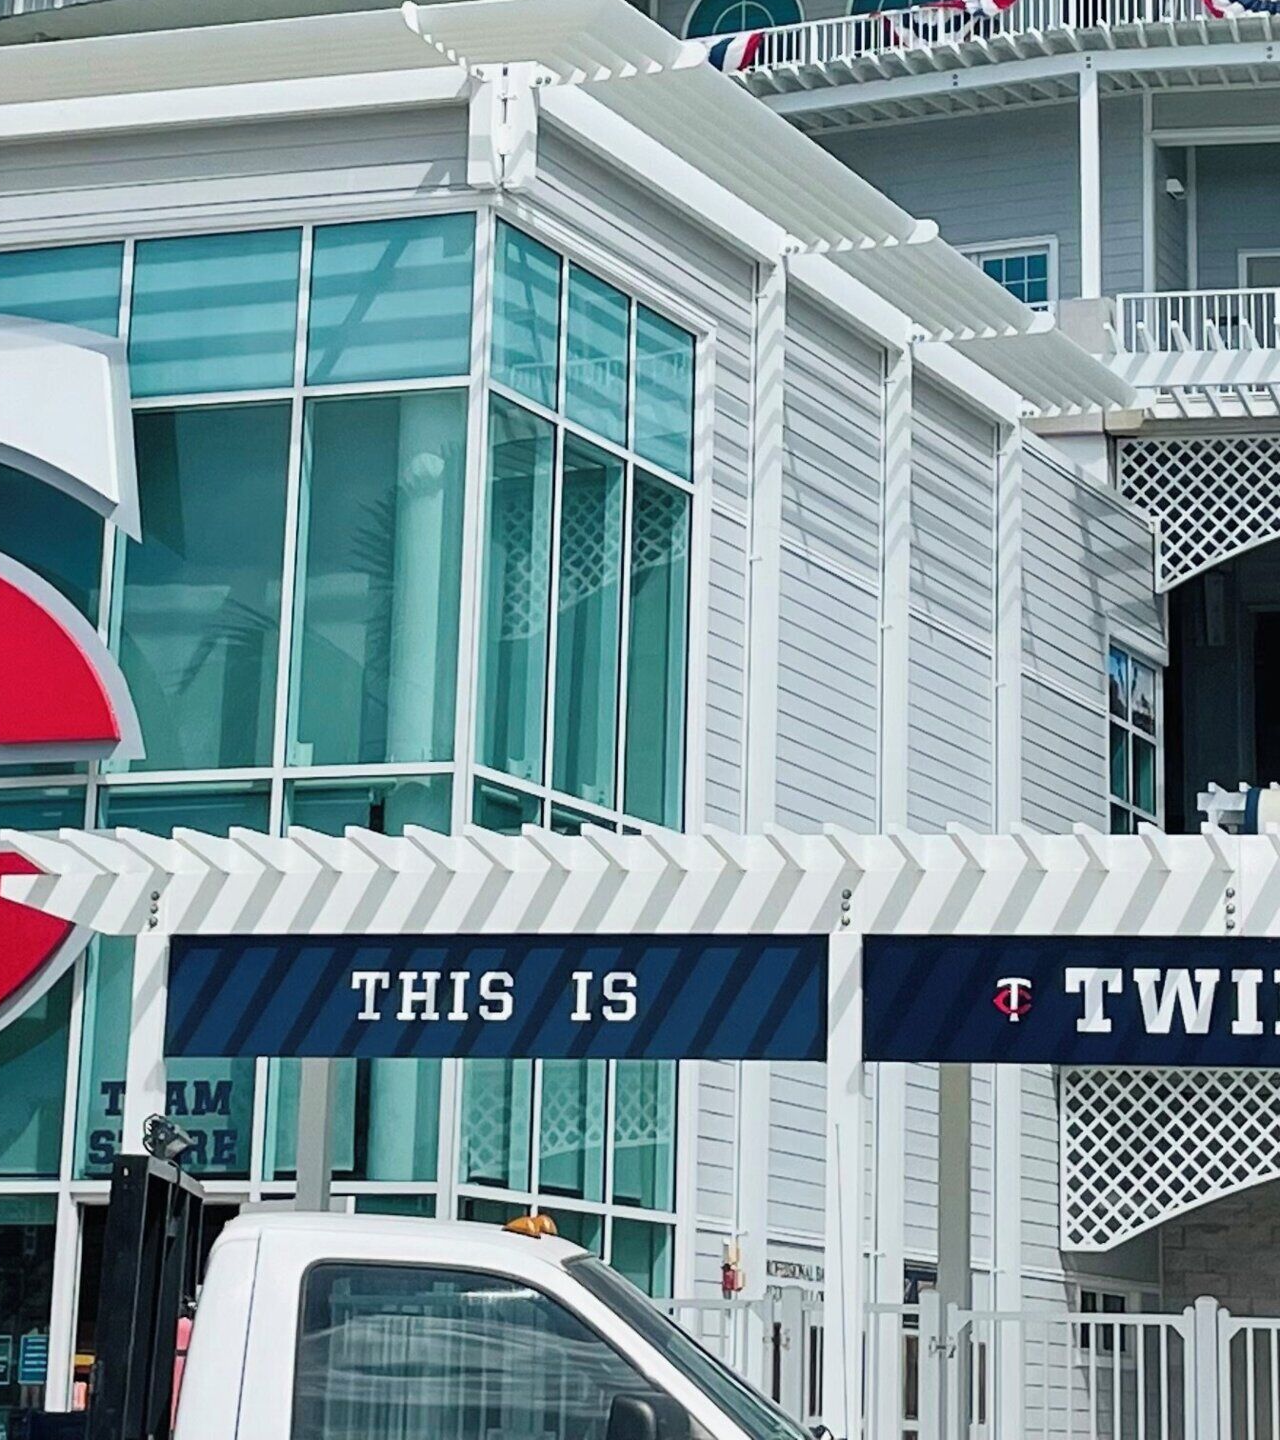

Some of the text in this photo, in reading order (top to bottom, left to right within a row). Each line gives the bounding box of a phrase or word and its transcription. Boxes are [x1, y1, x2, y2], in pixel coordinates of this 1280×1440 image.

[351, 971, 638, 1021] THIS IS
[101, 1081, 233, 1116] TAM
[89, 1130, 238, 1165] SRE
